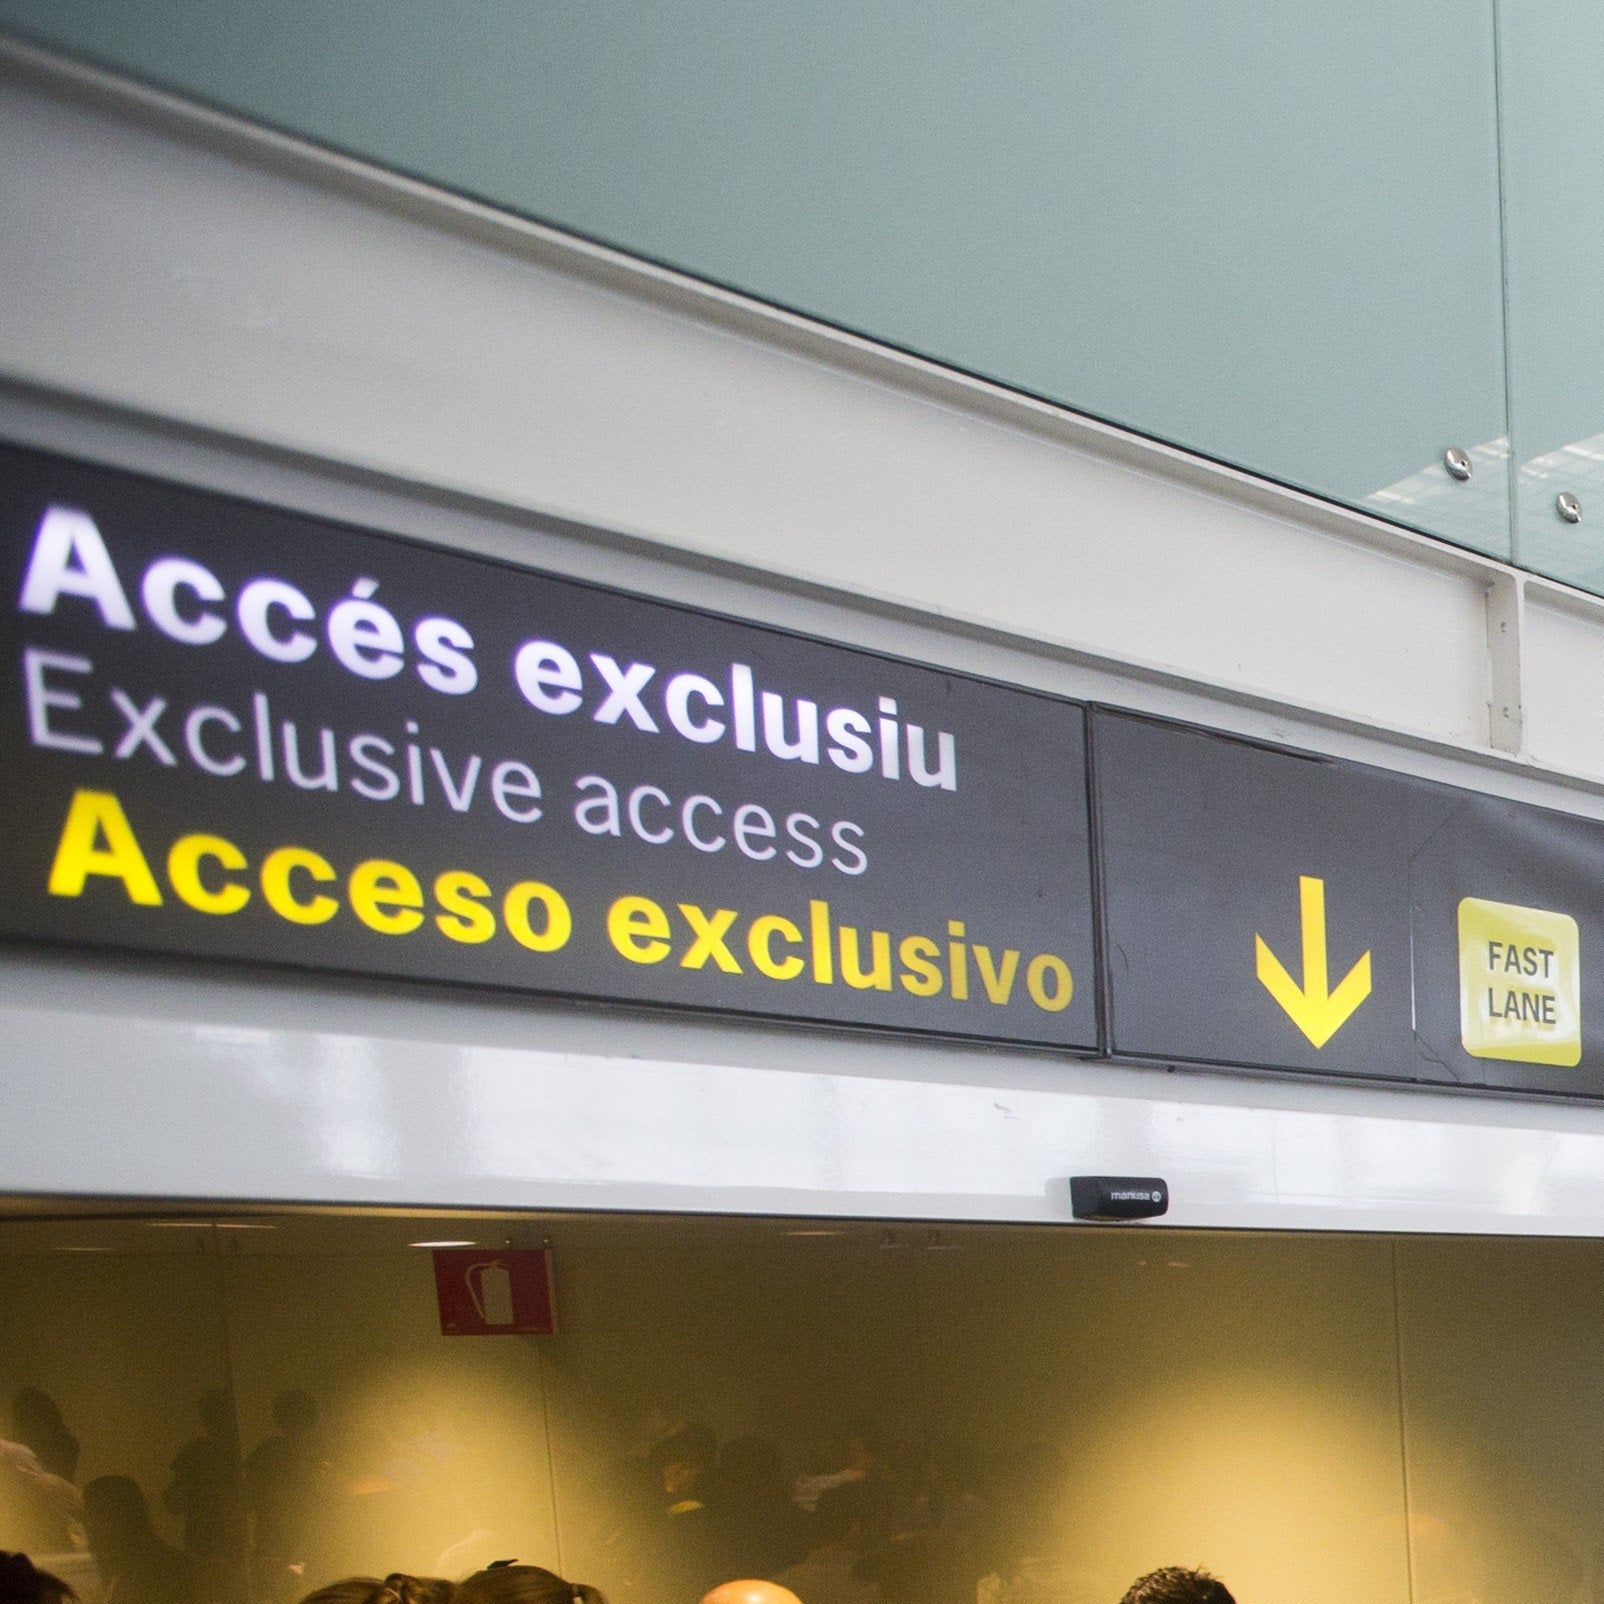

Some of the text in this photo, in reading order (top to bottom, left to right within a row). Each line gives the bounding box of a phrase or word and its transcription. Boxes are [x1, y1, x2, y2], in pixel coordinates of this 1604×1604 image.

[20, 506, 957, 791] Accés exclusiu
[22, 647, 869, 876] Exclusive access
[48, 788, 1076, 1013] Acceso exclusivo
[1488, 940, 1554, 978] FAST
[1488, 987, 1557, 1026] LANE
